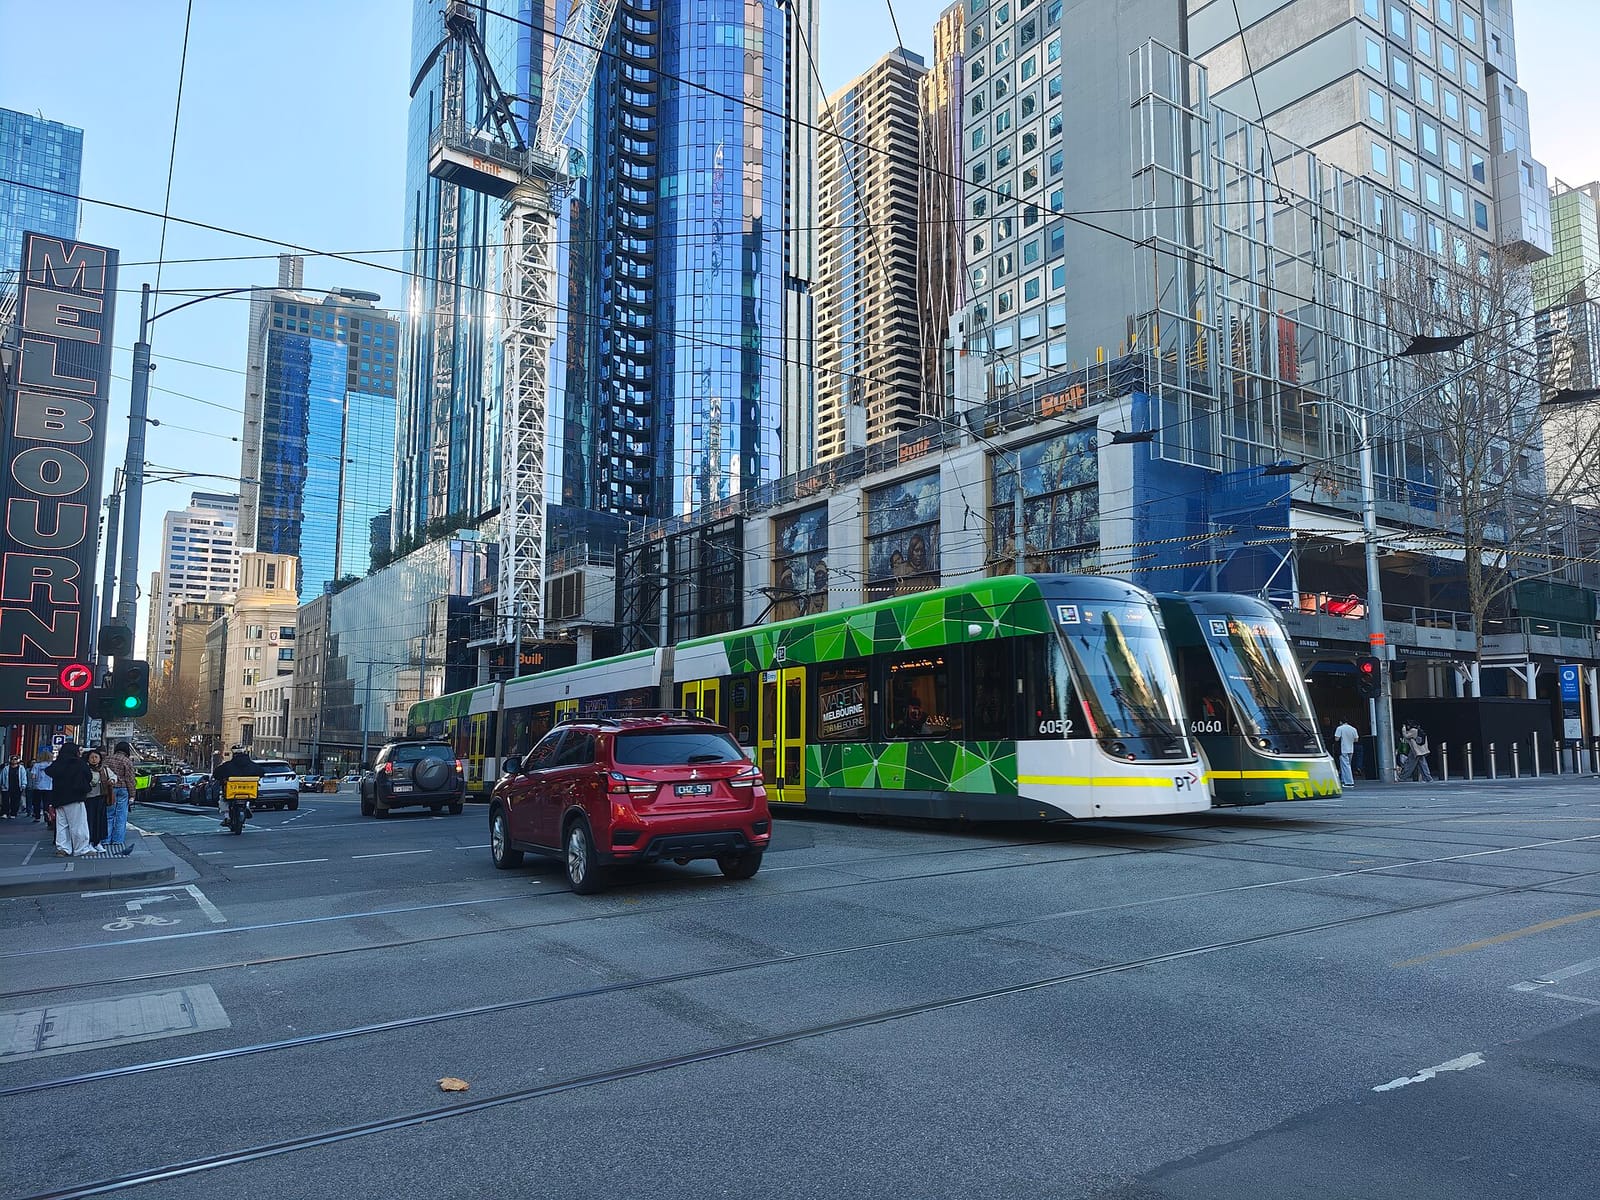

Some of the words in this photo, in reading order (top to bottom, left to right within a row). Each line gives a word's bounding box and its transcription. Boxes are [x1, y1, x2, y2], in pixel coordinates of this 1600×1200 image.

[473, 157, 502, 176] Built
[1041, 383, 1086, 416] Built
[0, 234, 106, 713] MELBOURNE
[823, 703, 864, 721] MELBOURNE
[1039, 720, 1073, 733] 6052
[1191, 720, 1222, 733] 6060
